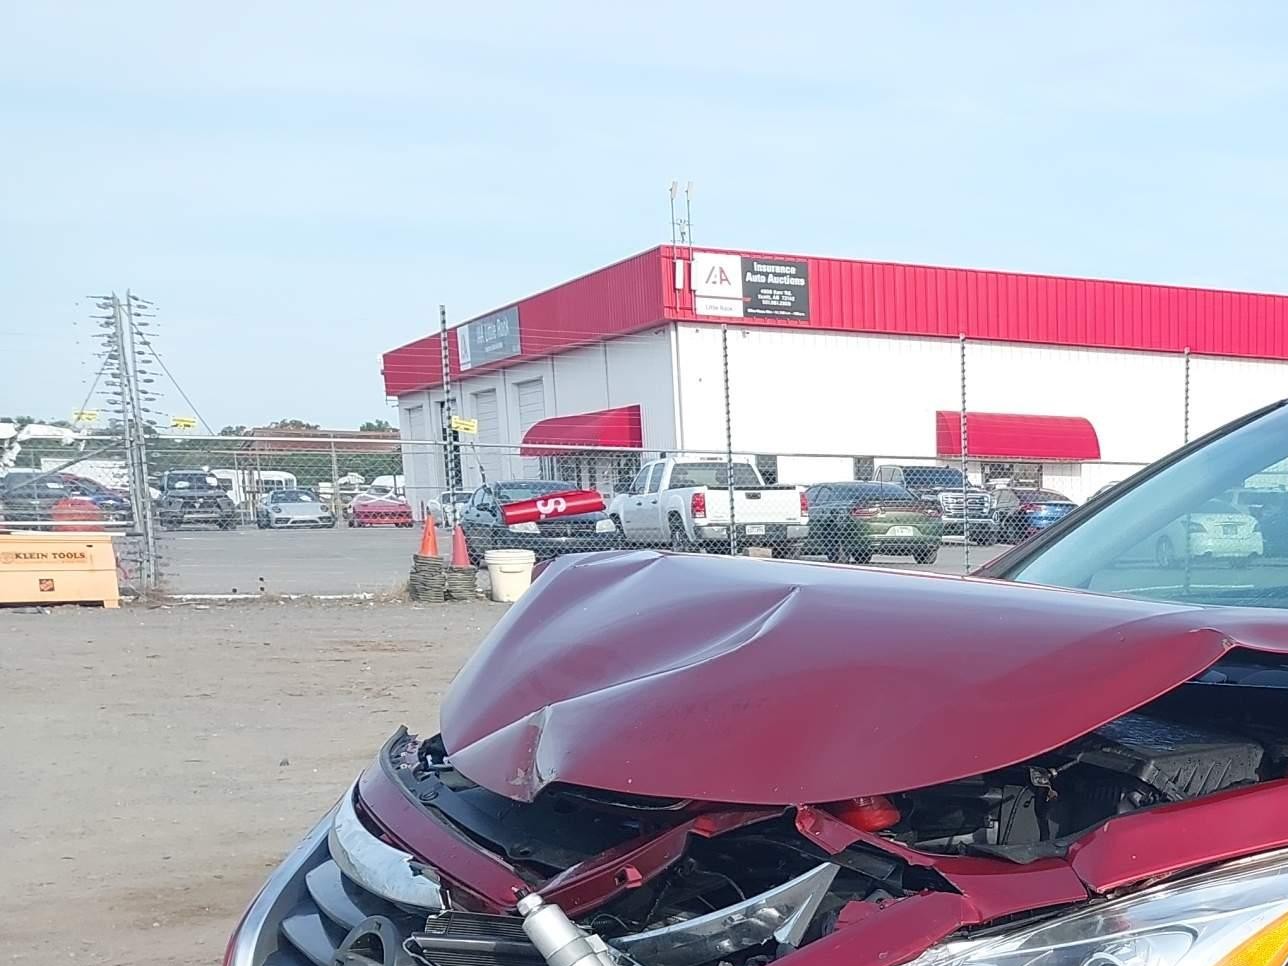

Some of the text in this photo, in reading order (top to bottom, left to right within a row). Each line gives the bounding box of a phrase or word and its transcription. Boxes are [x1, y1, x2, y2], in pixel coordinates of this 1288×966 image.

[753, 262, 796, 275] Insurance
[745, 272, 805, 286] Auto Auctions
[15, 552, 48, 560] KLEIN
